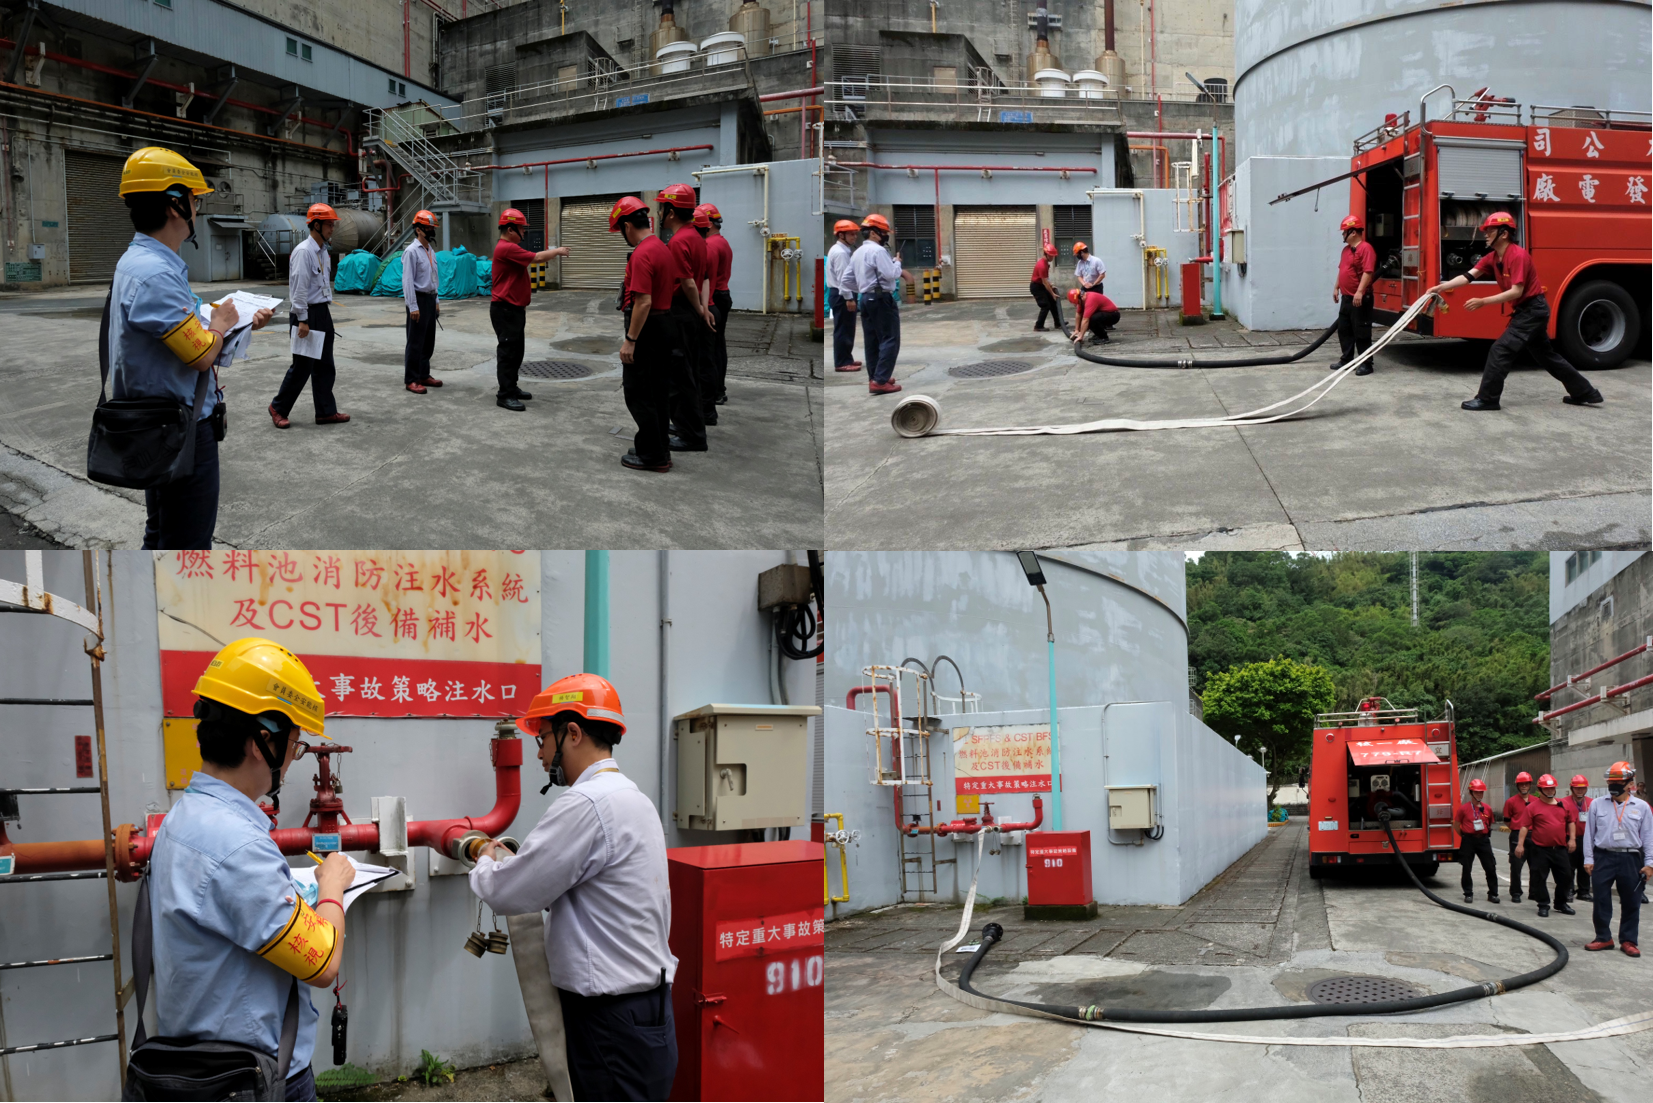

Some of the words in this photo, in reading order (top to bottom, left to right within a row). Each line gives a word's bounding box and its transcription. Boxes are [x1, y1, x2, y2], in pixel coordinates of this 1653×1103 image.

[176, 550, 529, 603] 燃料池消防注水系統
[230, 598, 494, 644] 及CST後備補水
[1013, 732, 1034, 742] CST
[766, 954, 823, 996] 910
